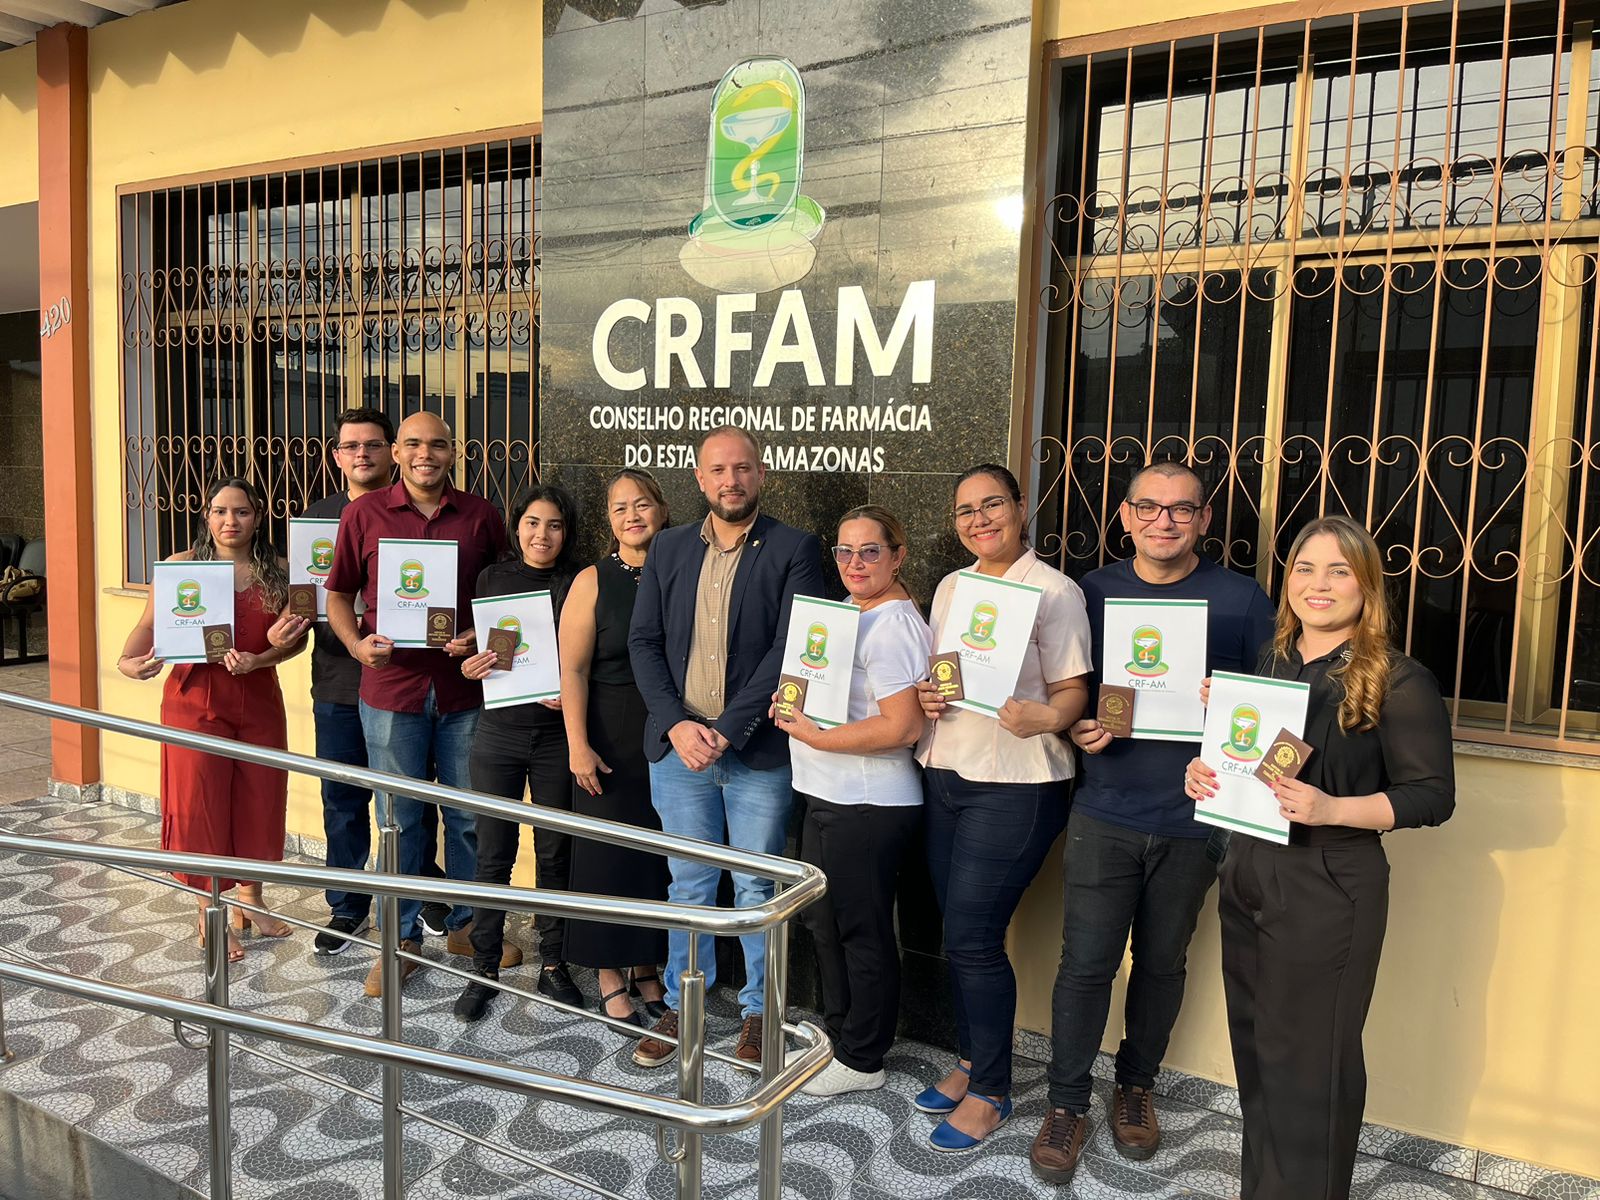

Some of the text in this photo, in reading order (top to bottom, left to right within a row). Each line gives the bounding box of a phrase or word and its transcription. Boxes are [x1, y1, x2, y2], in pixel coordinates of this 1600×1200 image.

[40, 296, 71, 339] 420
[592, 280, 936, 391] CRFAM
[589, 397, 932, 432] CONSELHO REGIONAL DE FARMÁCIA
[625, 444, 885, 473] DO ESTA AMAZONAS
[959, 648, 992, 665] CRF-AM
[800, 668, 825, 681] CRF-AM
[1128, 679, 1167, 689] CRF-AM
